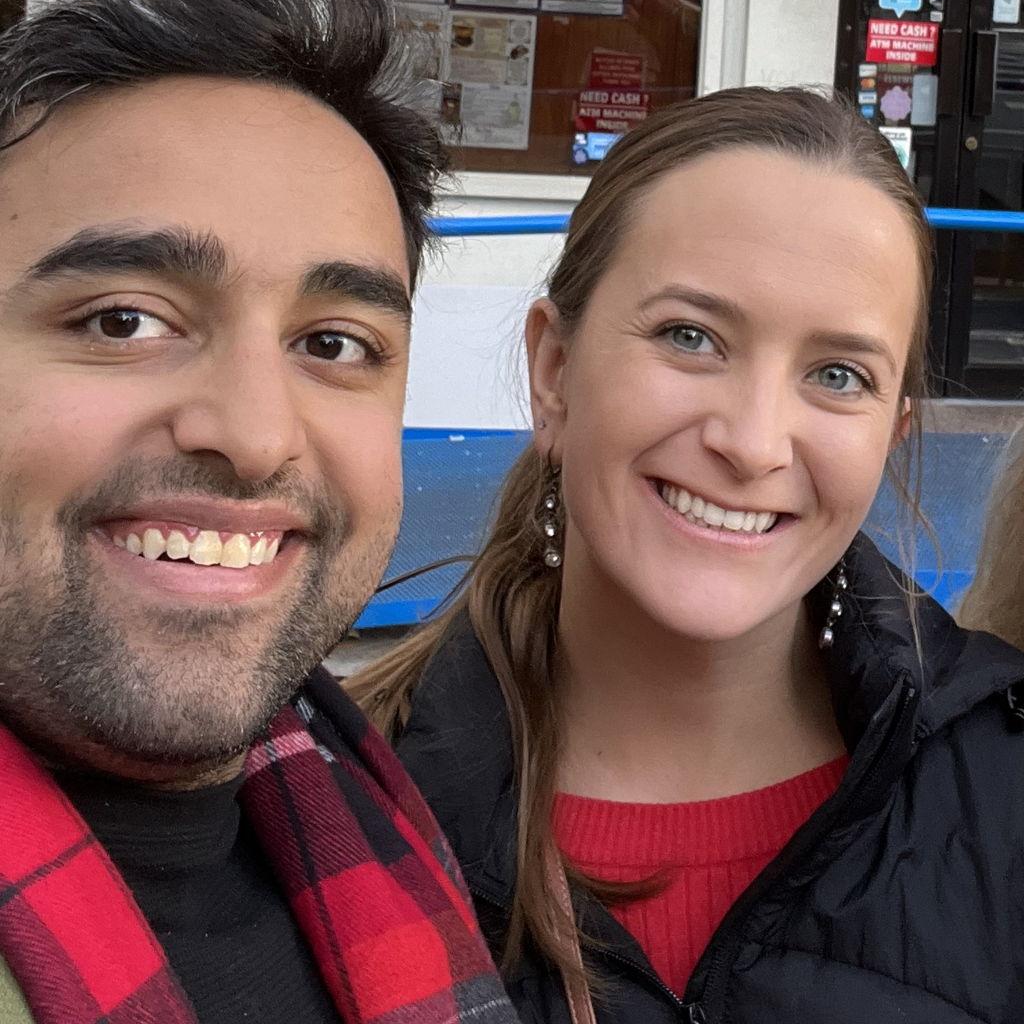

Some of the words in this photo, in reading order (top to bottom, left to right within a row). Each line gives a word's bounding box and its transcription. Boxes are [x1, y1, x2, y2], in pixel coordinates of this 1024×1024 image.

[870, 22, 899, 35] NEED
[900, 24, 928, 37] CASH
[929, 26, 936, 38] ?
[869, 39, 891, 49] ATM
[892, 40, 935, 53] MACHINE
[885, 50, 917, 62] INSIDE
[580, 91, 609, 104] NEED
[611, 92, 641, 105] CASH
